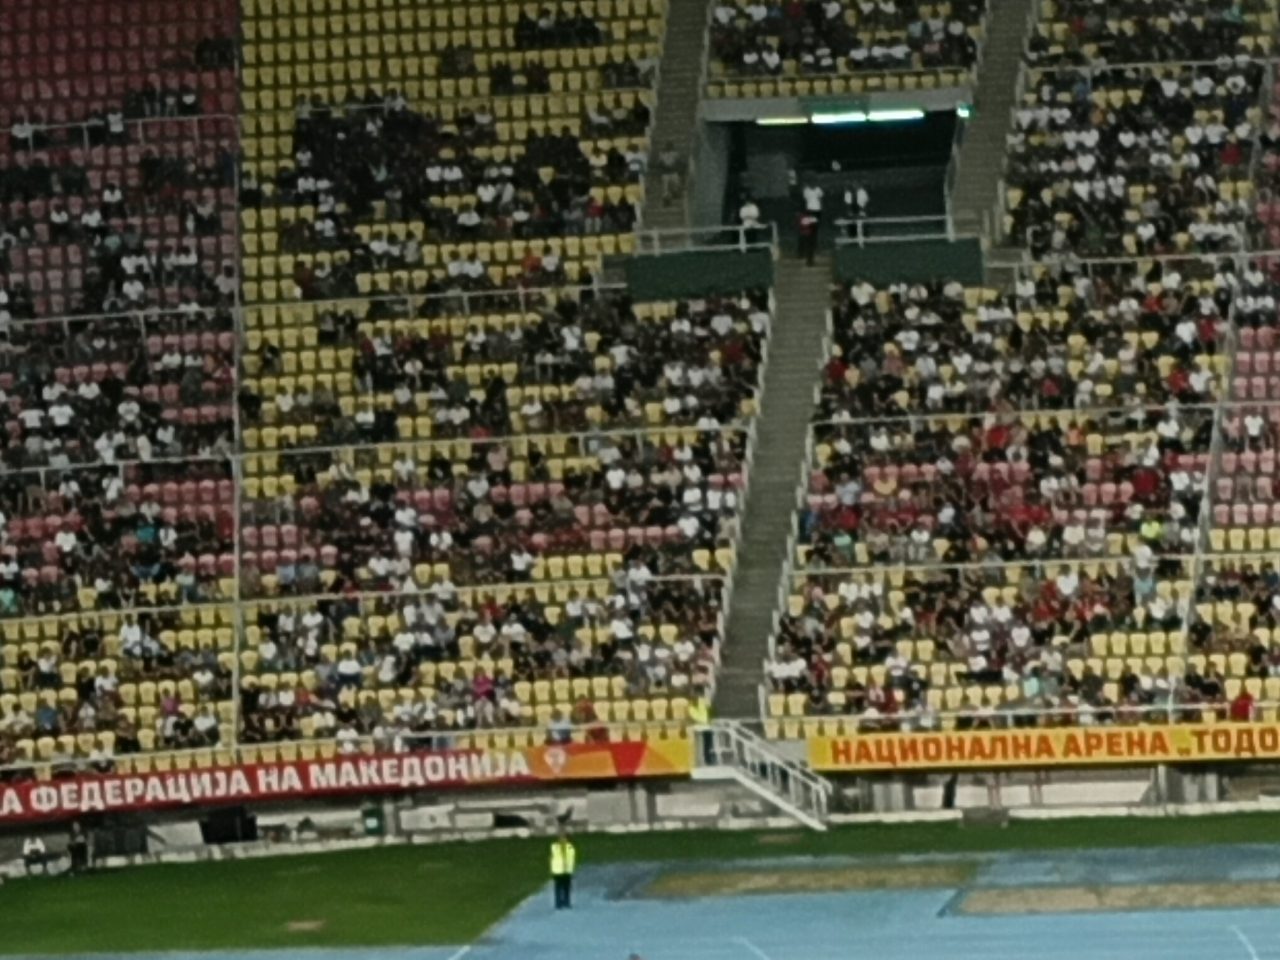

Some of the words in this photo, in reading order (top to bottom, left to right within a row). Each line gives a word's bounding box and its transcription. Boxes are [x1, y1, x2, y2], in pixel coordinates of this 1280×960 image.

[831, 733, 1056, 767] НАЦИОНАЛНА
[1061, 730, 1171, 759] АРЕНА
[29, 769, 252, 813] ФЕДЕРАЦИЈА
[256, 764, 303, 793] НА
[308, 750, 530, 790] МАКЕДОНИЈА
